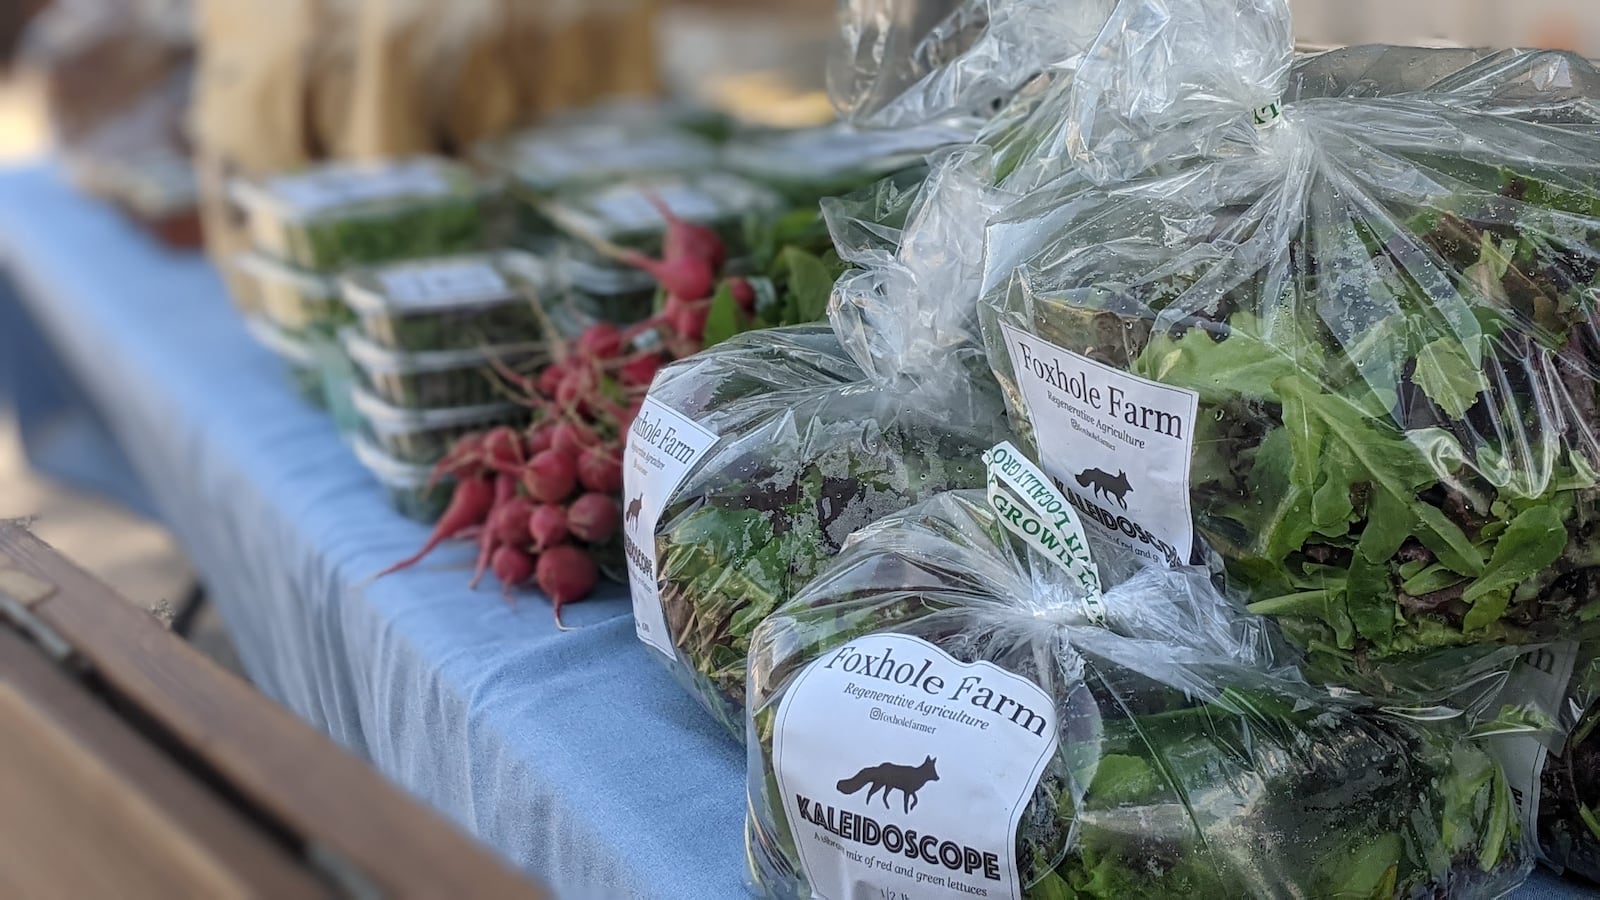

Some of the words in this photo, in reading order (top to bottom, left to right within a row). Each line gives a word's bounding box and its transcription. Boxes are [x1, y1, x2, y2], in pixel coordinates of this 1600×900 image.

[1018, 342, 1102, 409] Foxhole
[1107, 386, 1183, 440] Farm
[657, 426, 696, 465] Farm
[1047, 390, 1095, 425] Regenerative
[1096, 420, 1145, 449] Agriculture
[993, 448, 1022, 475] GRO
[1014, 470, 1071, 530] LOCALLY
[1134, 548, 1152, 559] and
[824, 646, 945, 696] Foxhole
[948, 676, 1048, 738] Farm
[844, 682, 916, 709] Regenerative
[915, 700, 990, 730] Agriculture
[796, 794, 1001, 882] KALEIDOSCOPE
[846, 850, 863, 863] mix
[864, 855, 876, 869] of
[876, 860, 892, 872] red
[895, 866, 914, 878] and
[916, 871, 945, 887] green
[947, 877, 988, 897] lettuces
